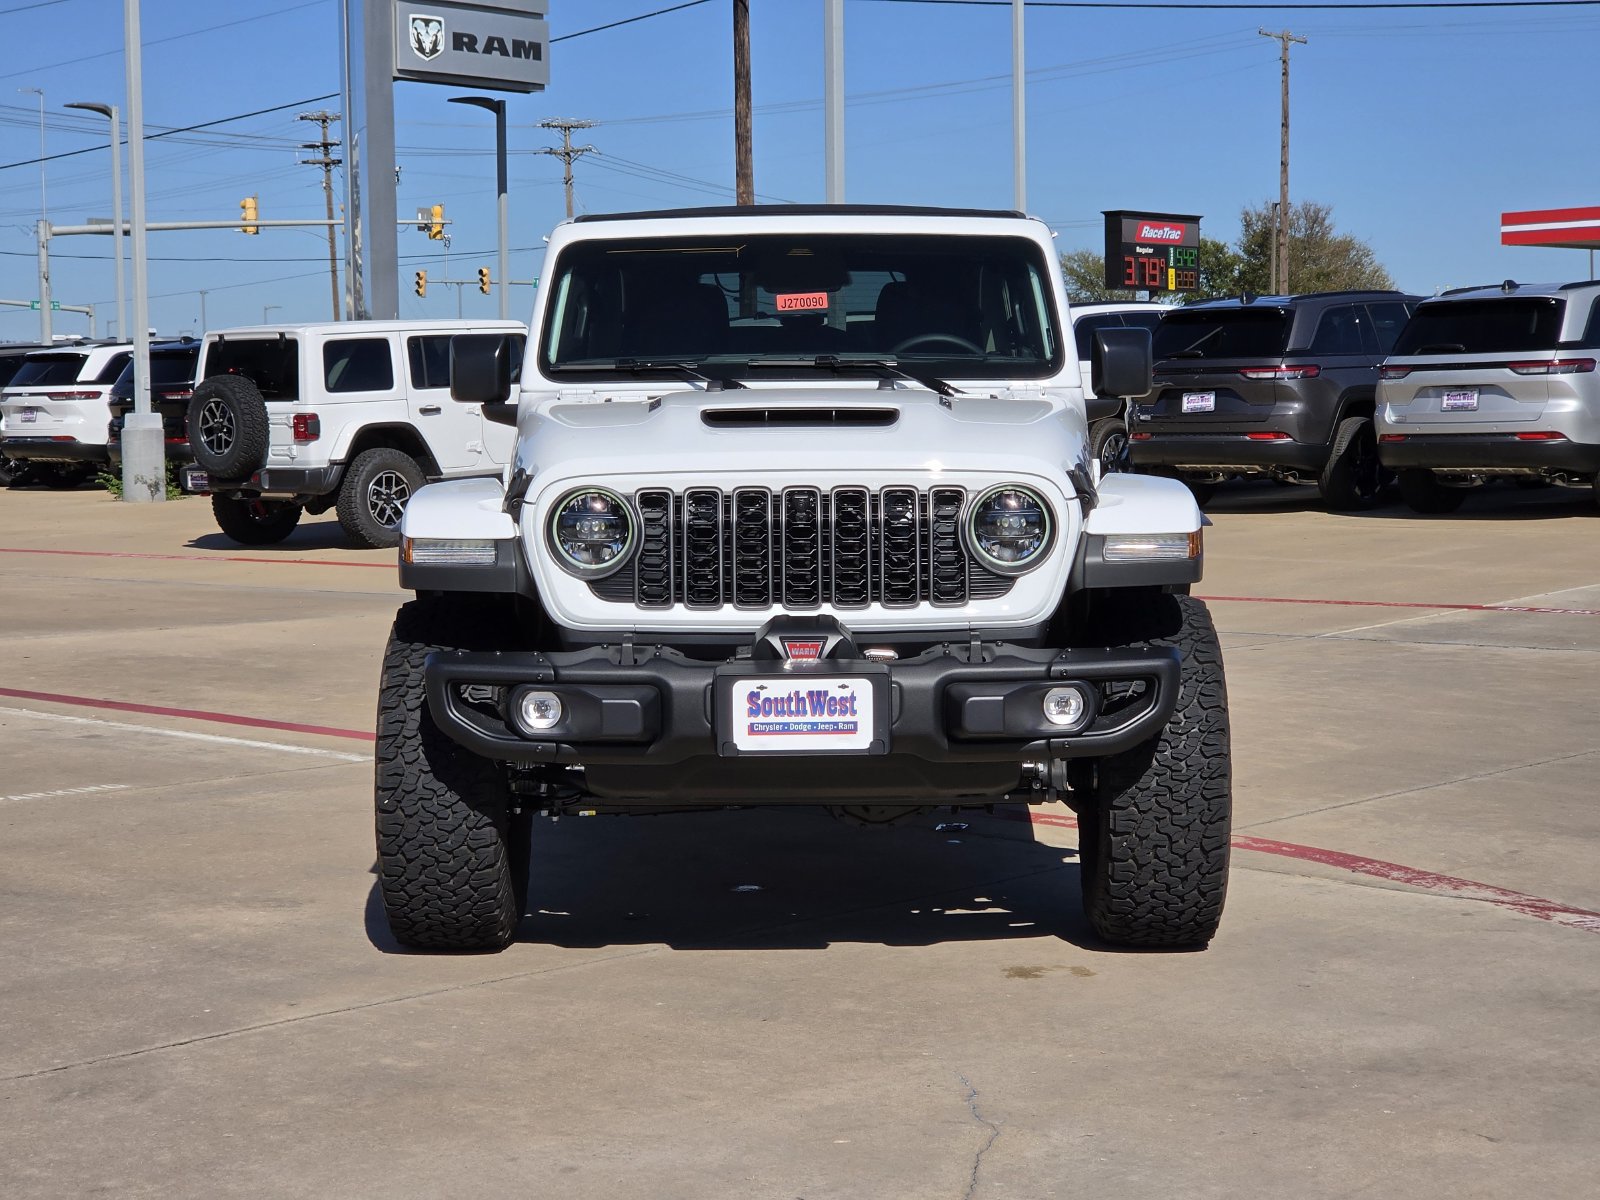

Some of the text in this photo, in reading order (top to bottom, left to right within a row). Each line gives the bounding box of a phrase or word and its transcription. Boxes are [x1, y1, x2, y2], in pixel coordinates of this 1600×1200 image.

[452, 32, 542, 61] RAM
[1141, 225, 1181, 239] RaceTrac
[781, 296, 824, 309] J270090
[791, 647, 816, 656] WARN
[746, 689, 858, 718] SouthWest
[753, 721, 854, 732] Chrysler Dodge Jeep Ram
